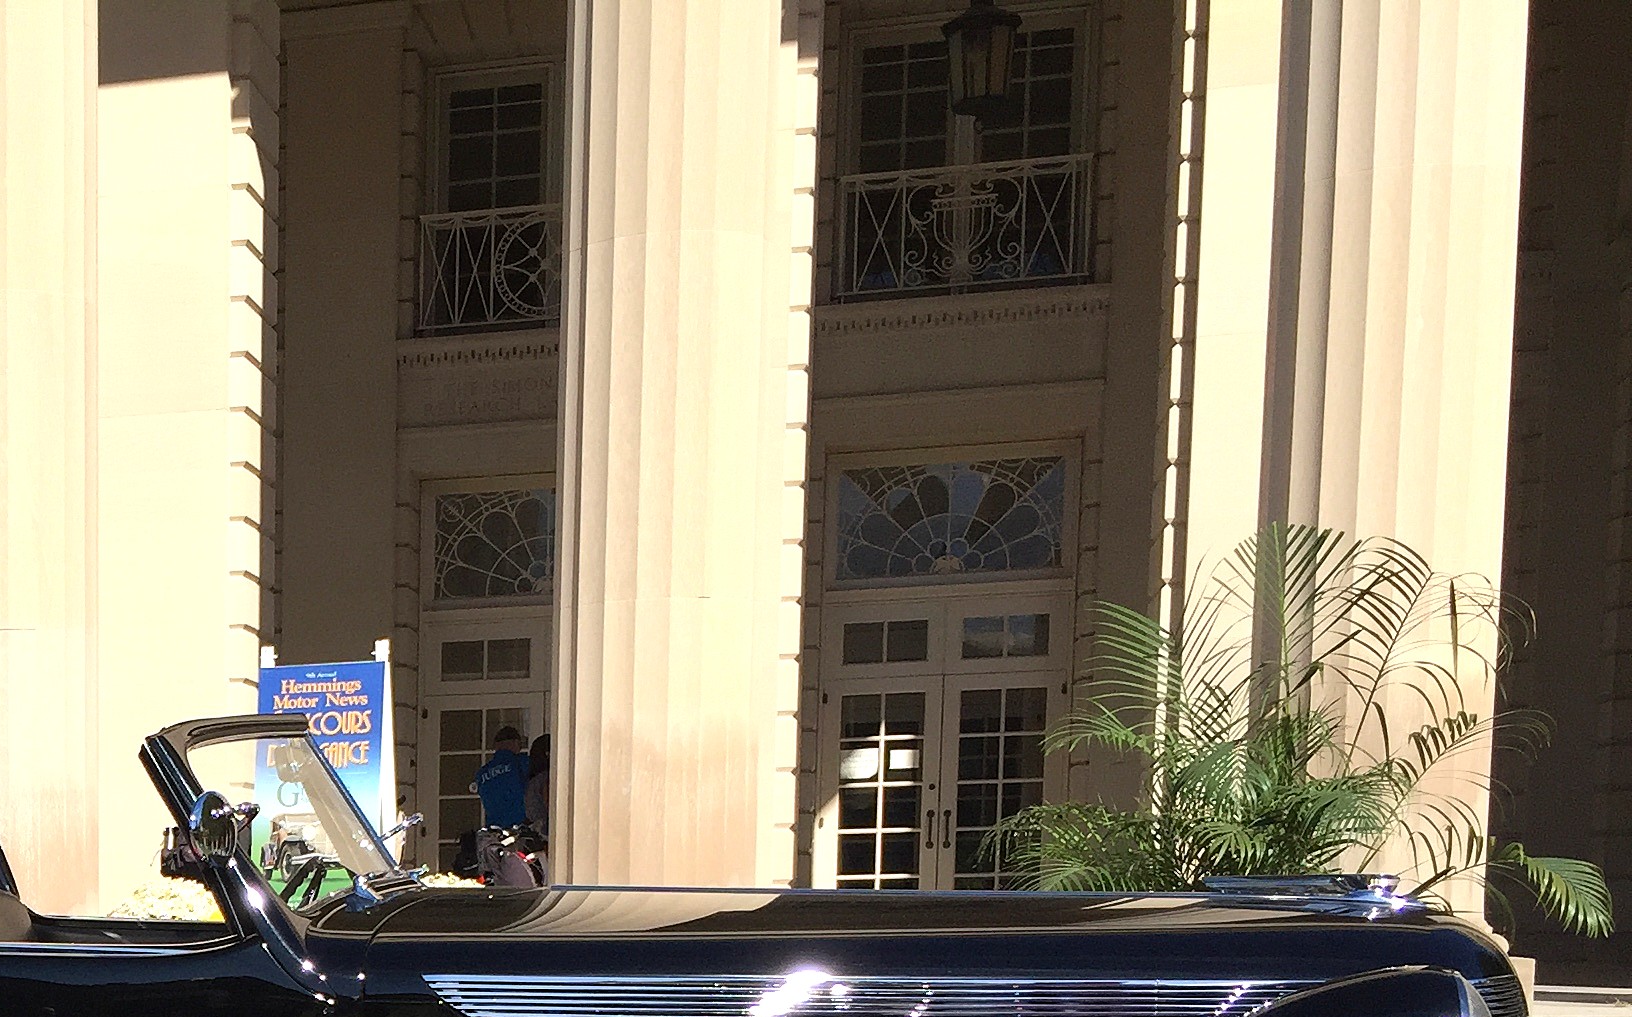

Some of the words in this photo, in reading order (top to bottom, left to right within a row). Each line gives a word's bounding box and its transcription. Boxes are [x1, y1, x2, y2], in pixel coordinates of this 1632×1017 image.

[280, 678, 361, 694] Hemmings
[272, 695, 318, 710] Motor
[325, 693, 368, 707] News
[480, 764, 512, 784] JUDGE
